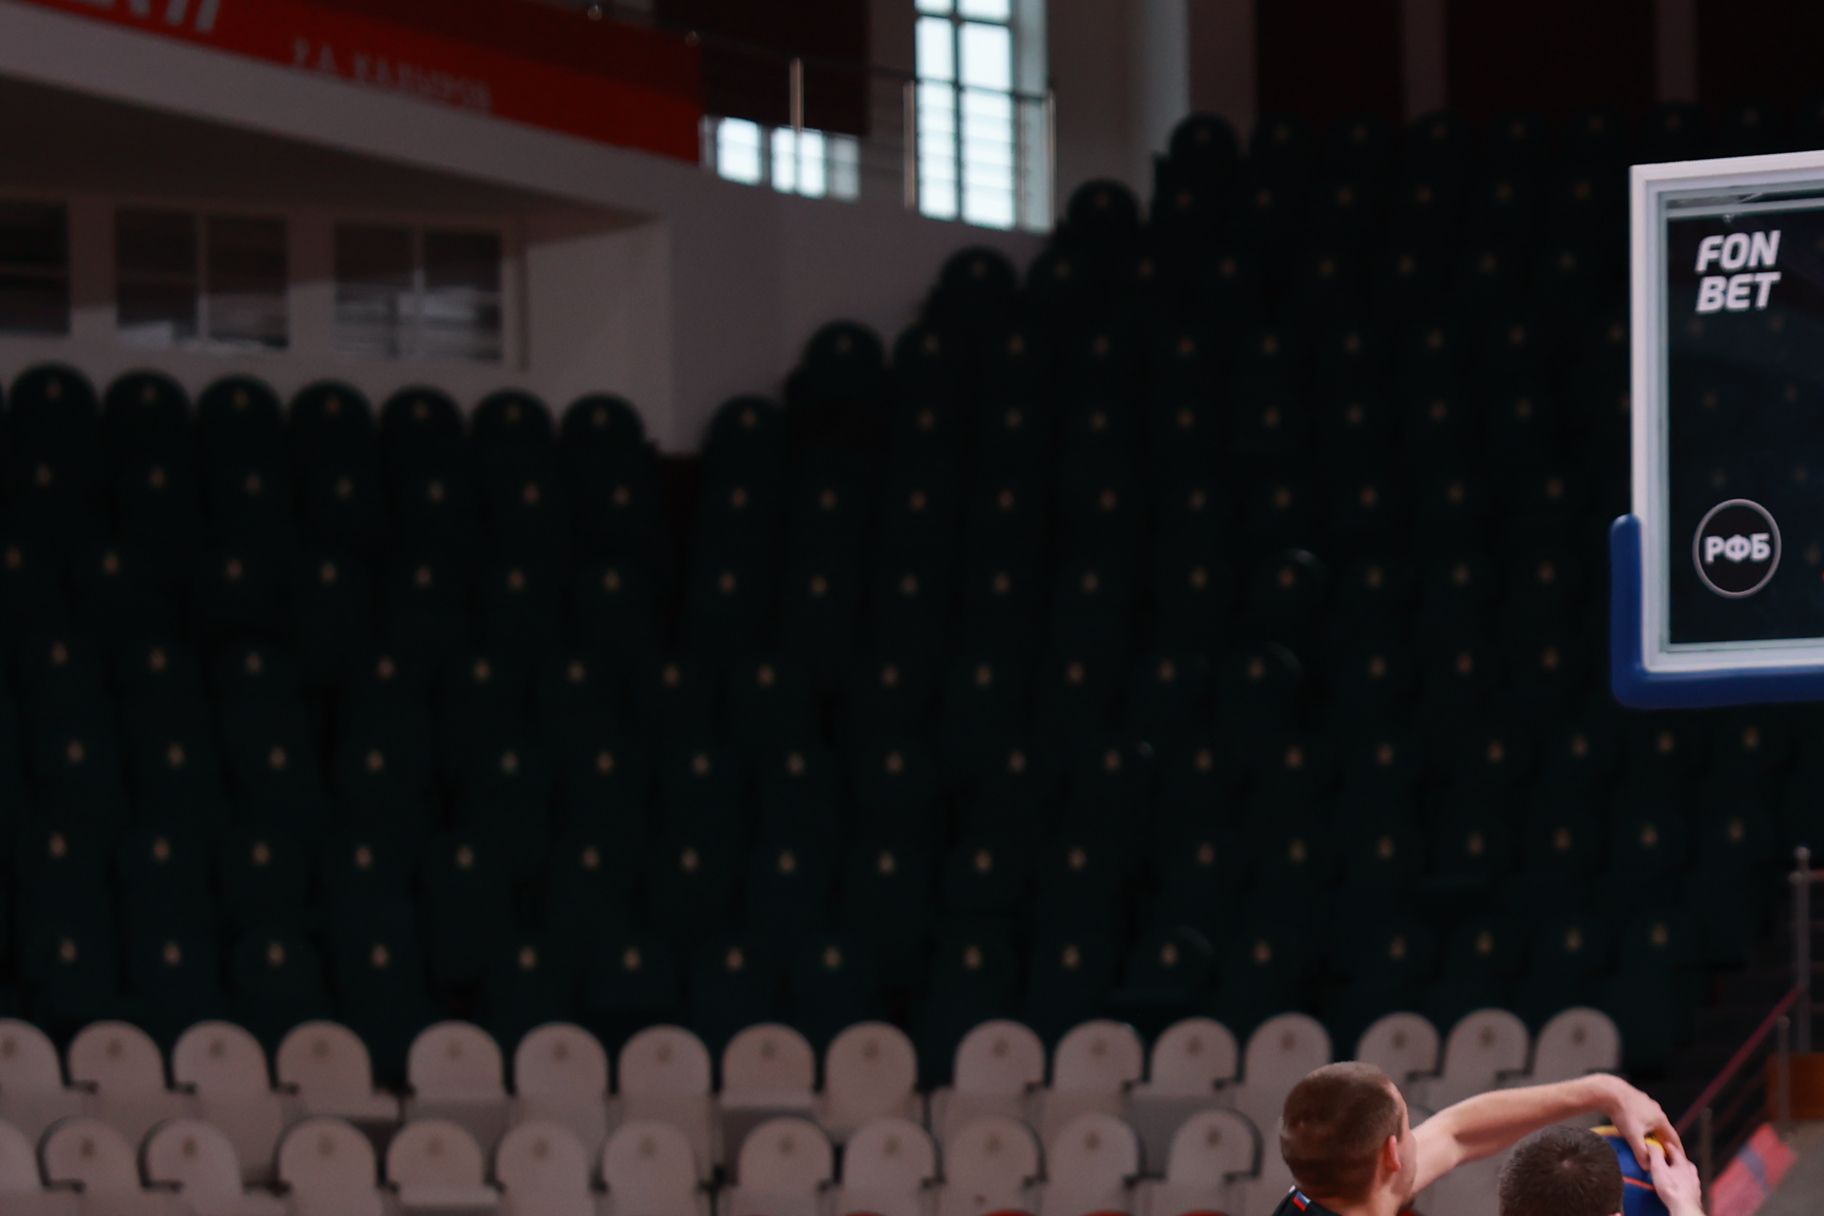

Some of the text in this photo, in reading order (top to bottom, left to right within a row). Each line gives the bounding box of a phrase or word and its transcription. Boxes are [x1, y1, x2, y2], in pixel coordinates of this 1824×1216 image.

[1695, 230, 1781, 274] FON
[1695, 271, 1781, 314] BET
[1704, 532, 1771, 564] РФБ
